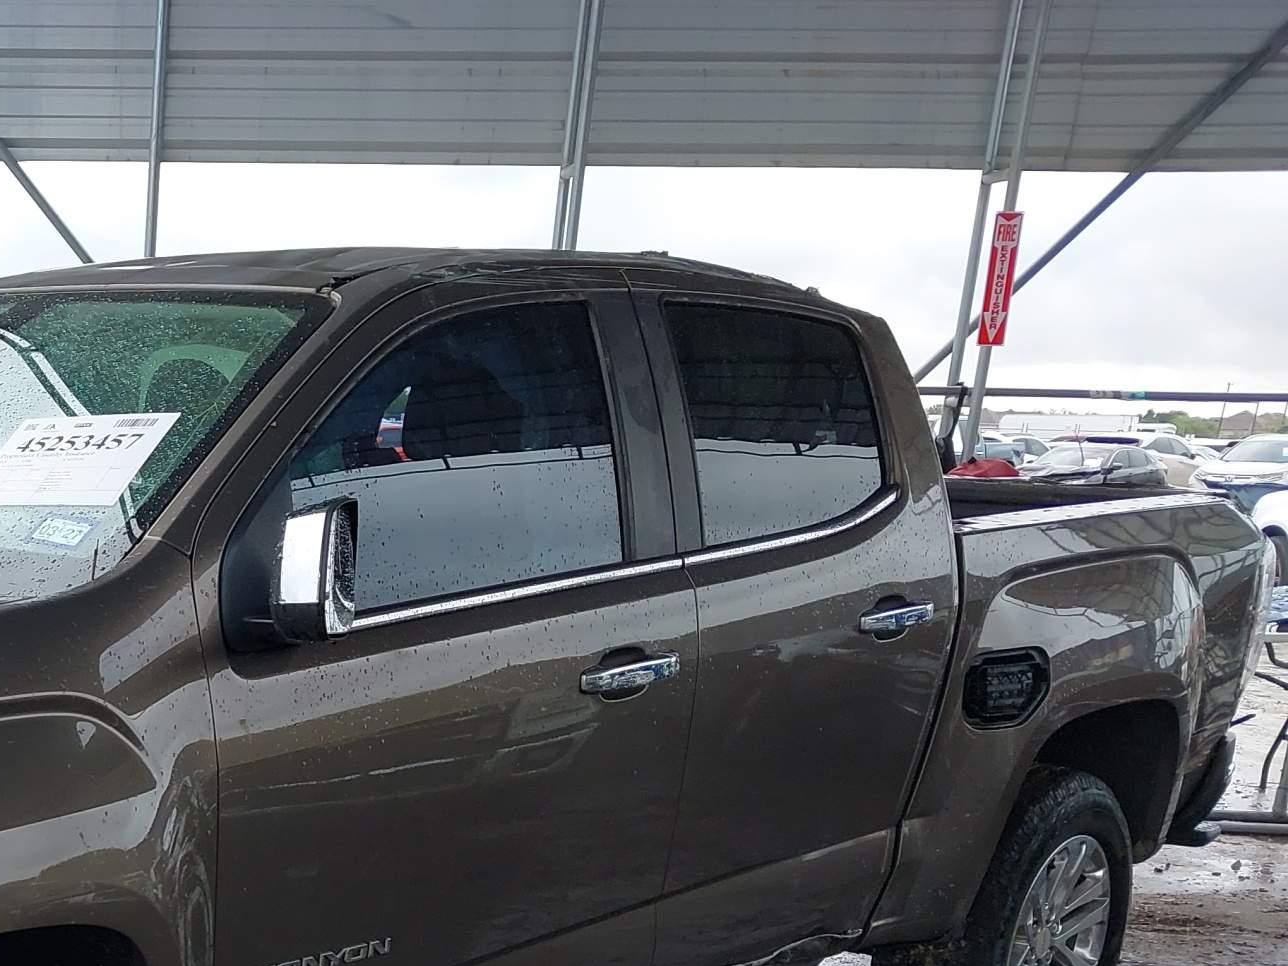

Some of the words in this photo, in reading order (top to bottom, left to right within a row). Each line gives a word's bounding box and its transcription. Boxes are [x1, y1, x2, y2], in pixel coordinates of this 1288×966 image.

[996, 223, 1018, 242] FIRE
[989, 244, 1009, 330] EXTINGUISHER
[16, 432, 145, 453] 45253457
